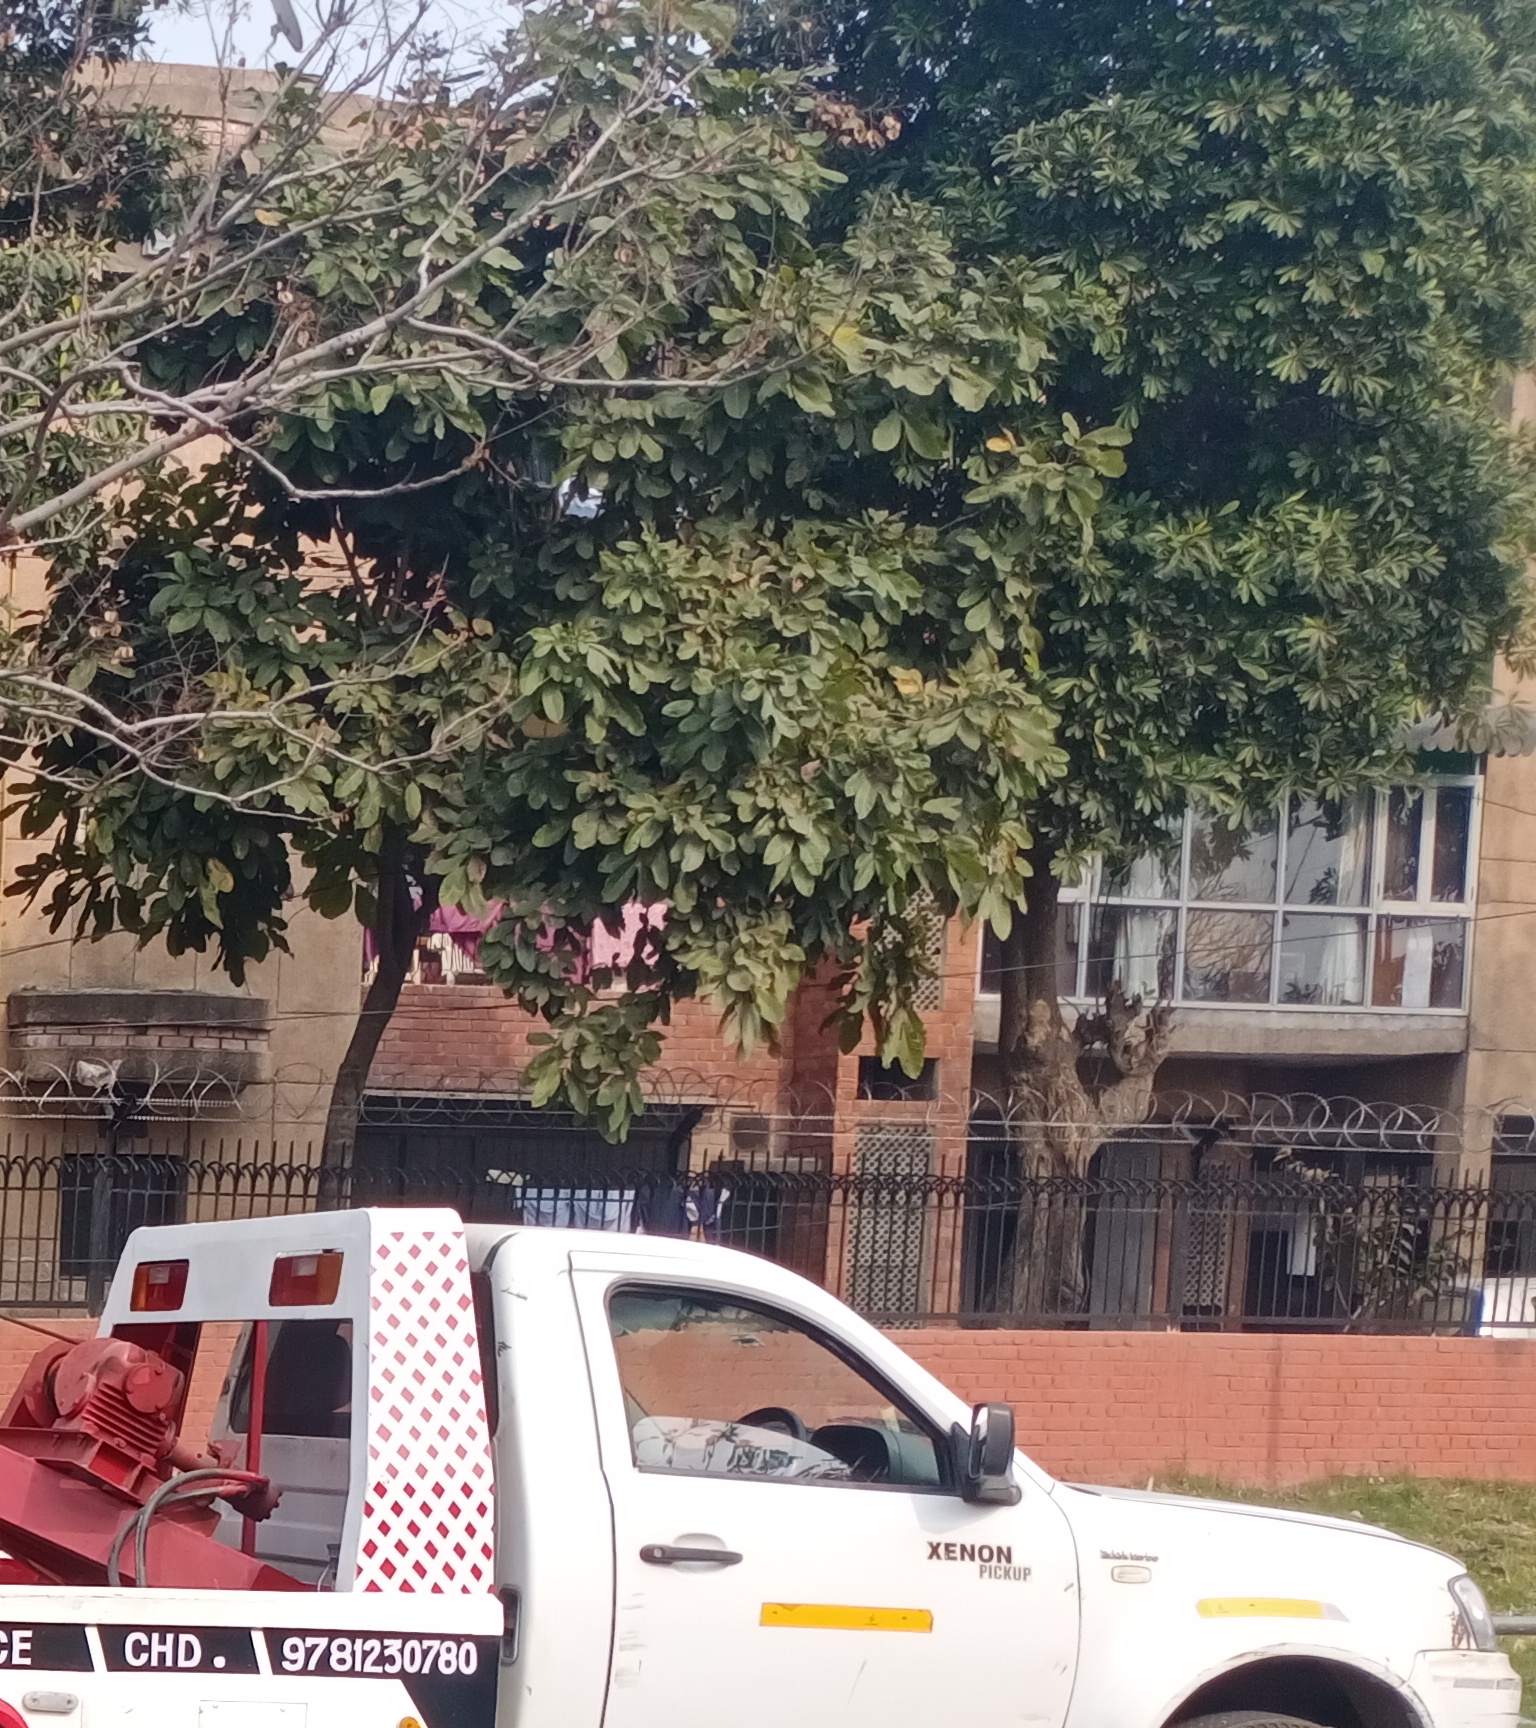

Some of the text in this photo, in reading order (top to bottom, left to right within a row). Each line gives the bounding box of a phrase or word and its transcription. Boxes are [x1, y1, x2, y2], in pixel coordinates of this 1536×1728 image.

[926, 1541, 1013, 1565] XENON
[979, 1565, 1032, 1582] PICKUP
[281, 1636, 479, 1676] 9781230780
